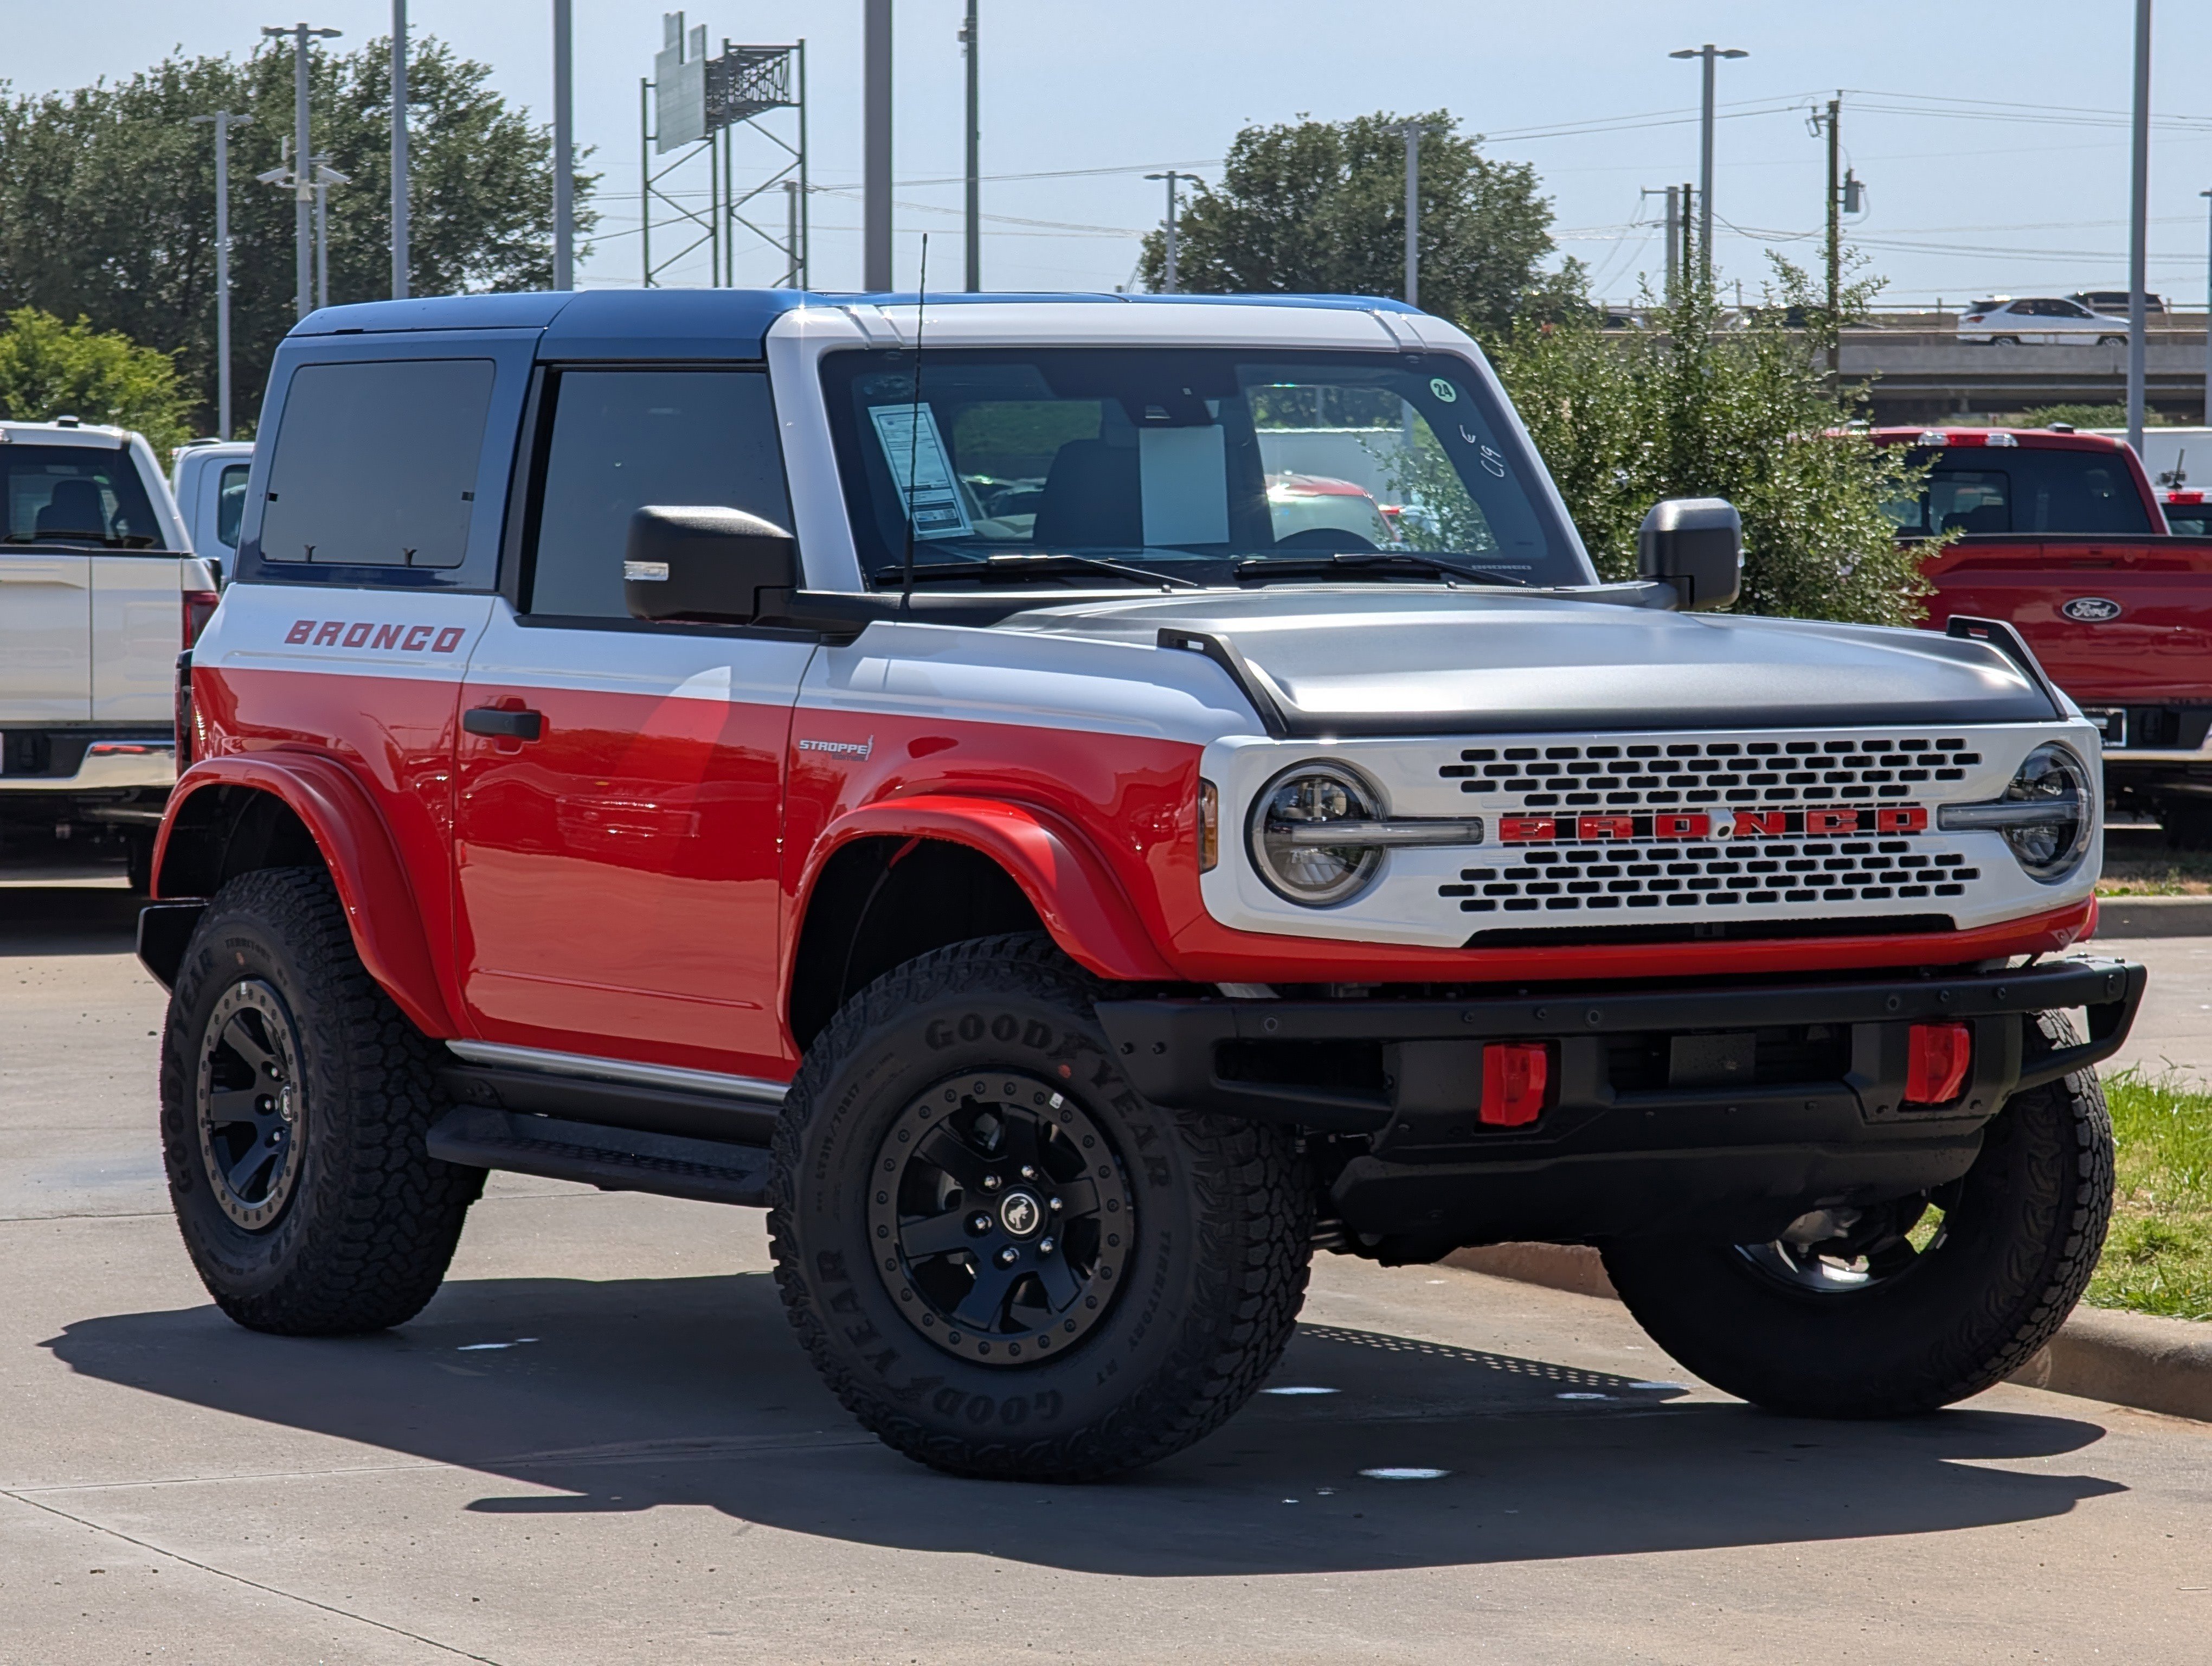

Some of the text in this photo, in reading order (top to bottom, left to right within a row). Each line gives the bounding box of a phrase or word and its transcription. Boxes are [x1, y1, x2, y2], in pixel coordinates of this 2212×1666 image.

[1433, 383, 1453, 397] 24
[2070, 600, 2113, 618] Ford
[284, 620, 466, 653] BRONCO
[799, 740, 868, 754] STROPPE
[1499, 807, 1928, 842] BRONCO
